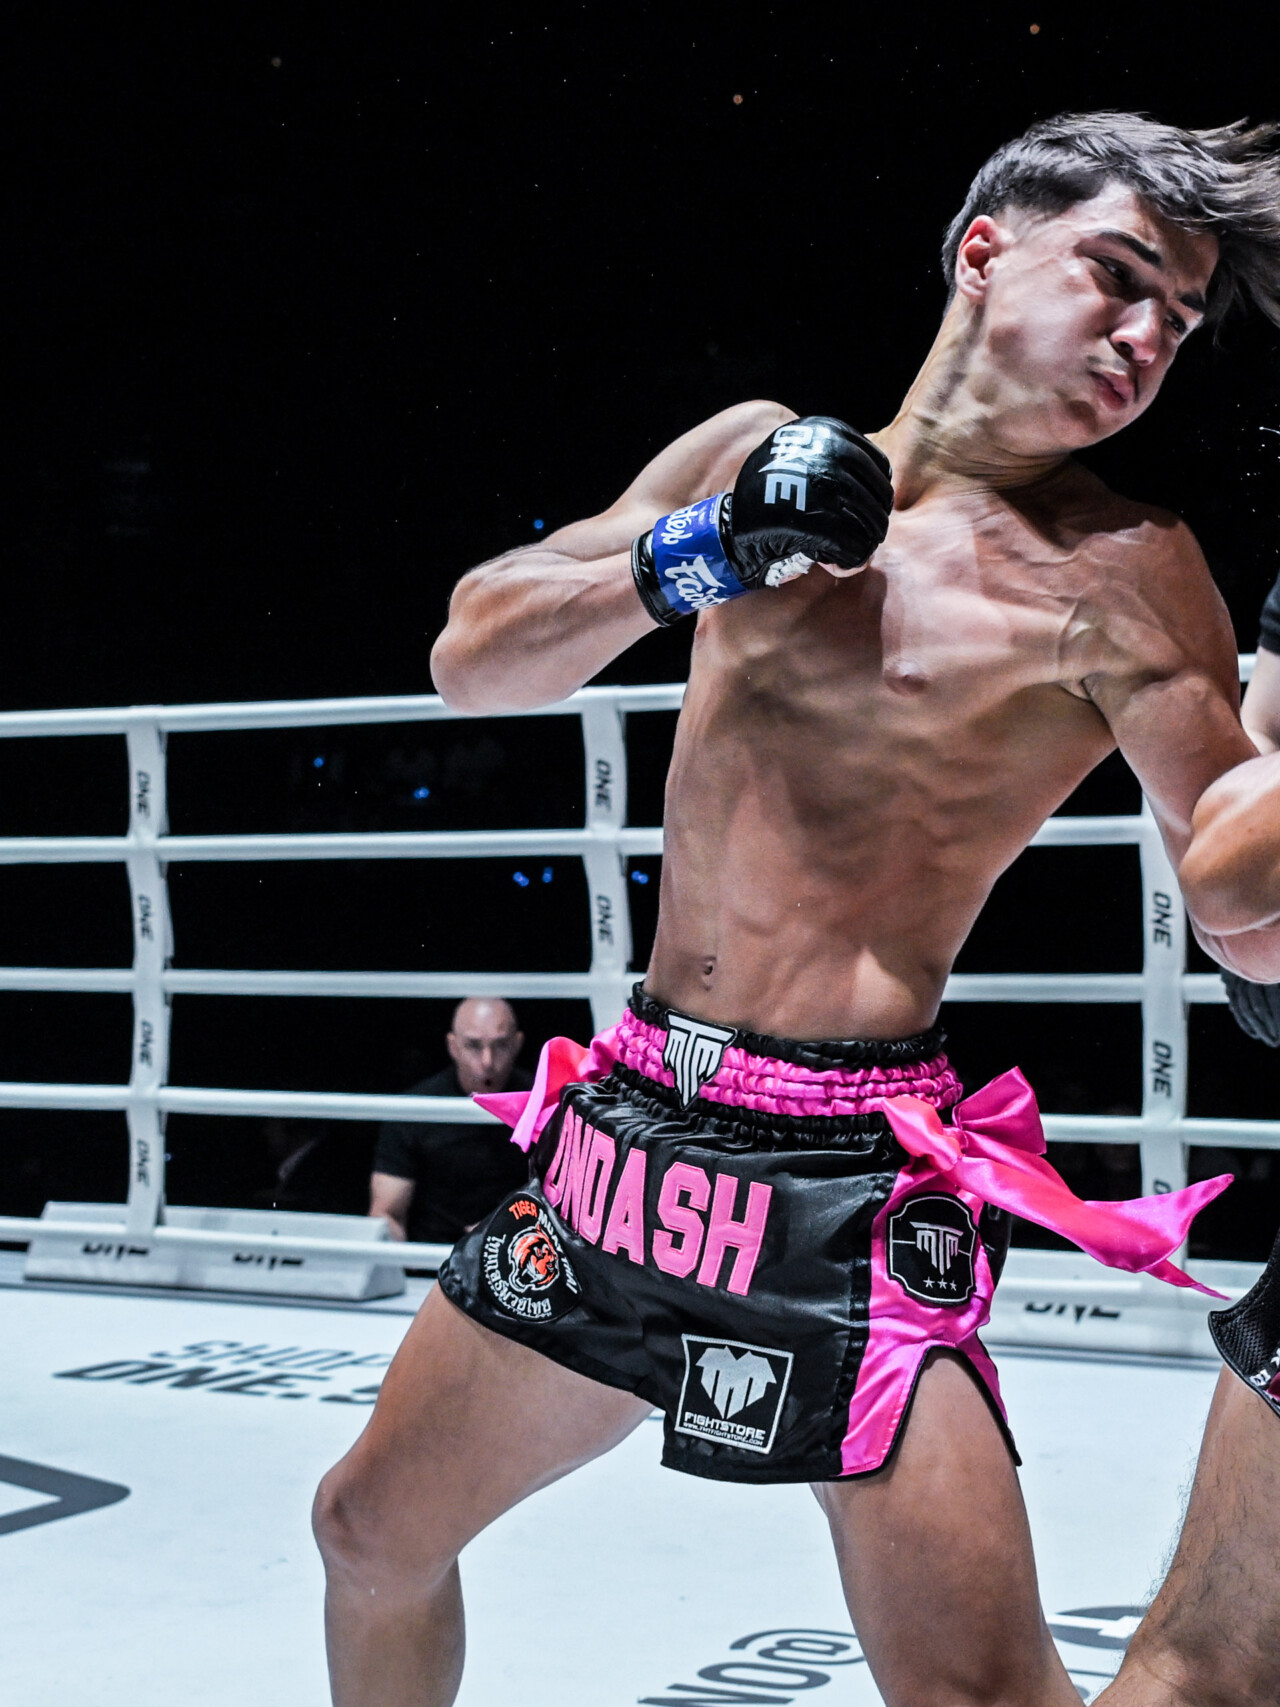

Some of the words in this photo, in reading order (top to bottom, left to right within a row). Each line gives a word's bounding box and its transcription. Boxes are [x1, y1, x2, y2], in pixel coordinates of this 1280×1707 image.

[1151, 891, 1173, 948] ONE
[1151, 1040, 1174, 1098] ONE
[509, 1200, 538, 1220] TIGER
[543, 1104, 773, 1296] ONDASH
[684, 1411, 766, 1440] FIGHTSTORE
